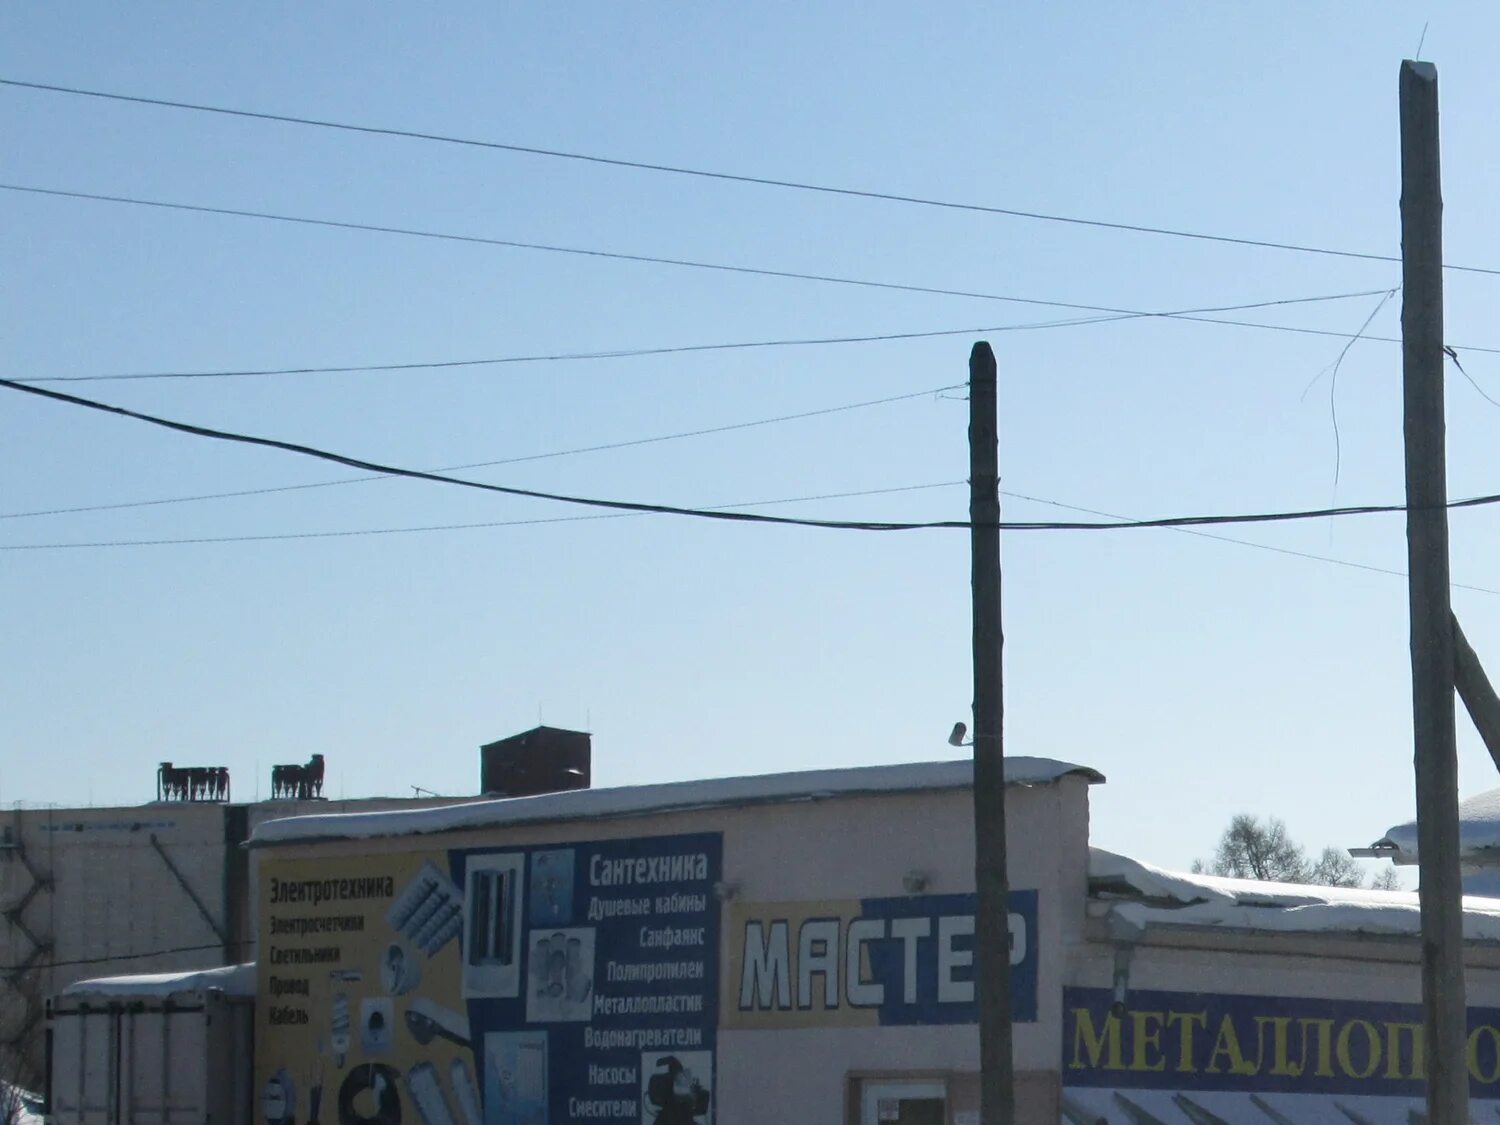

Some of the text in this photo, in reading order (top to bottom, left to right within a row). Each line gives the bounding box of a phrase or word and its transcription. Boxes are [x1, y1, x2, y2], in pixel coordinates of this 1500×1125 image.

[590, 853, 708, 886] Сантехника
[269, 876, 393, 906] Электротехника
[588, 892, 706, 920] Душевые кабины
[270, 915, 364, 937] Электросчетчики
[640, 926, 705, 950] Санфаянс
[269, 946, 341, 966] Светильники
[607, 960, 704, 983] Полипропилен
[269, 976, 310, 996] Провод
[268, 1006, 309, 1025] Кабель
[593, 992, 703, 1016] Металлопластик
[584, 1027, 702, 1050] Водонагреватели
[588, 1064, 637, 1085] Насосы
[568, 1097, 637, 1118] Смесители
